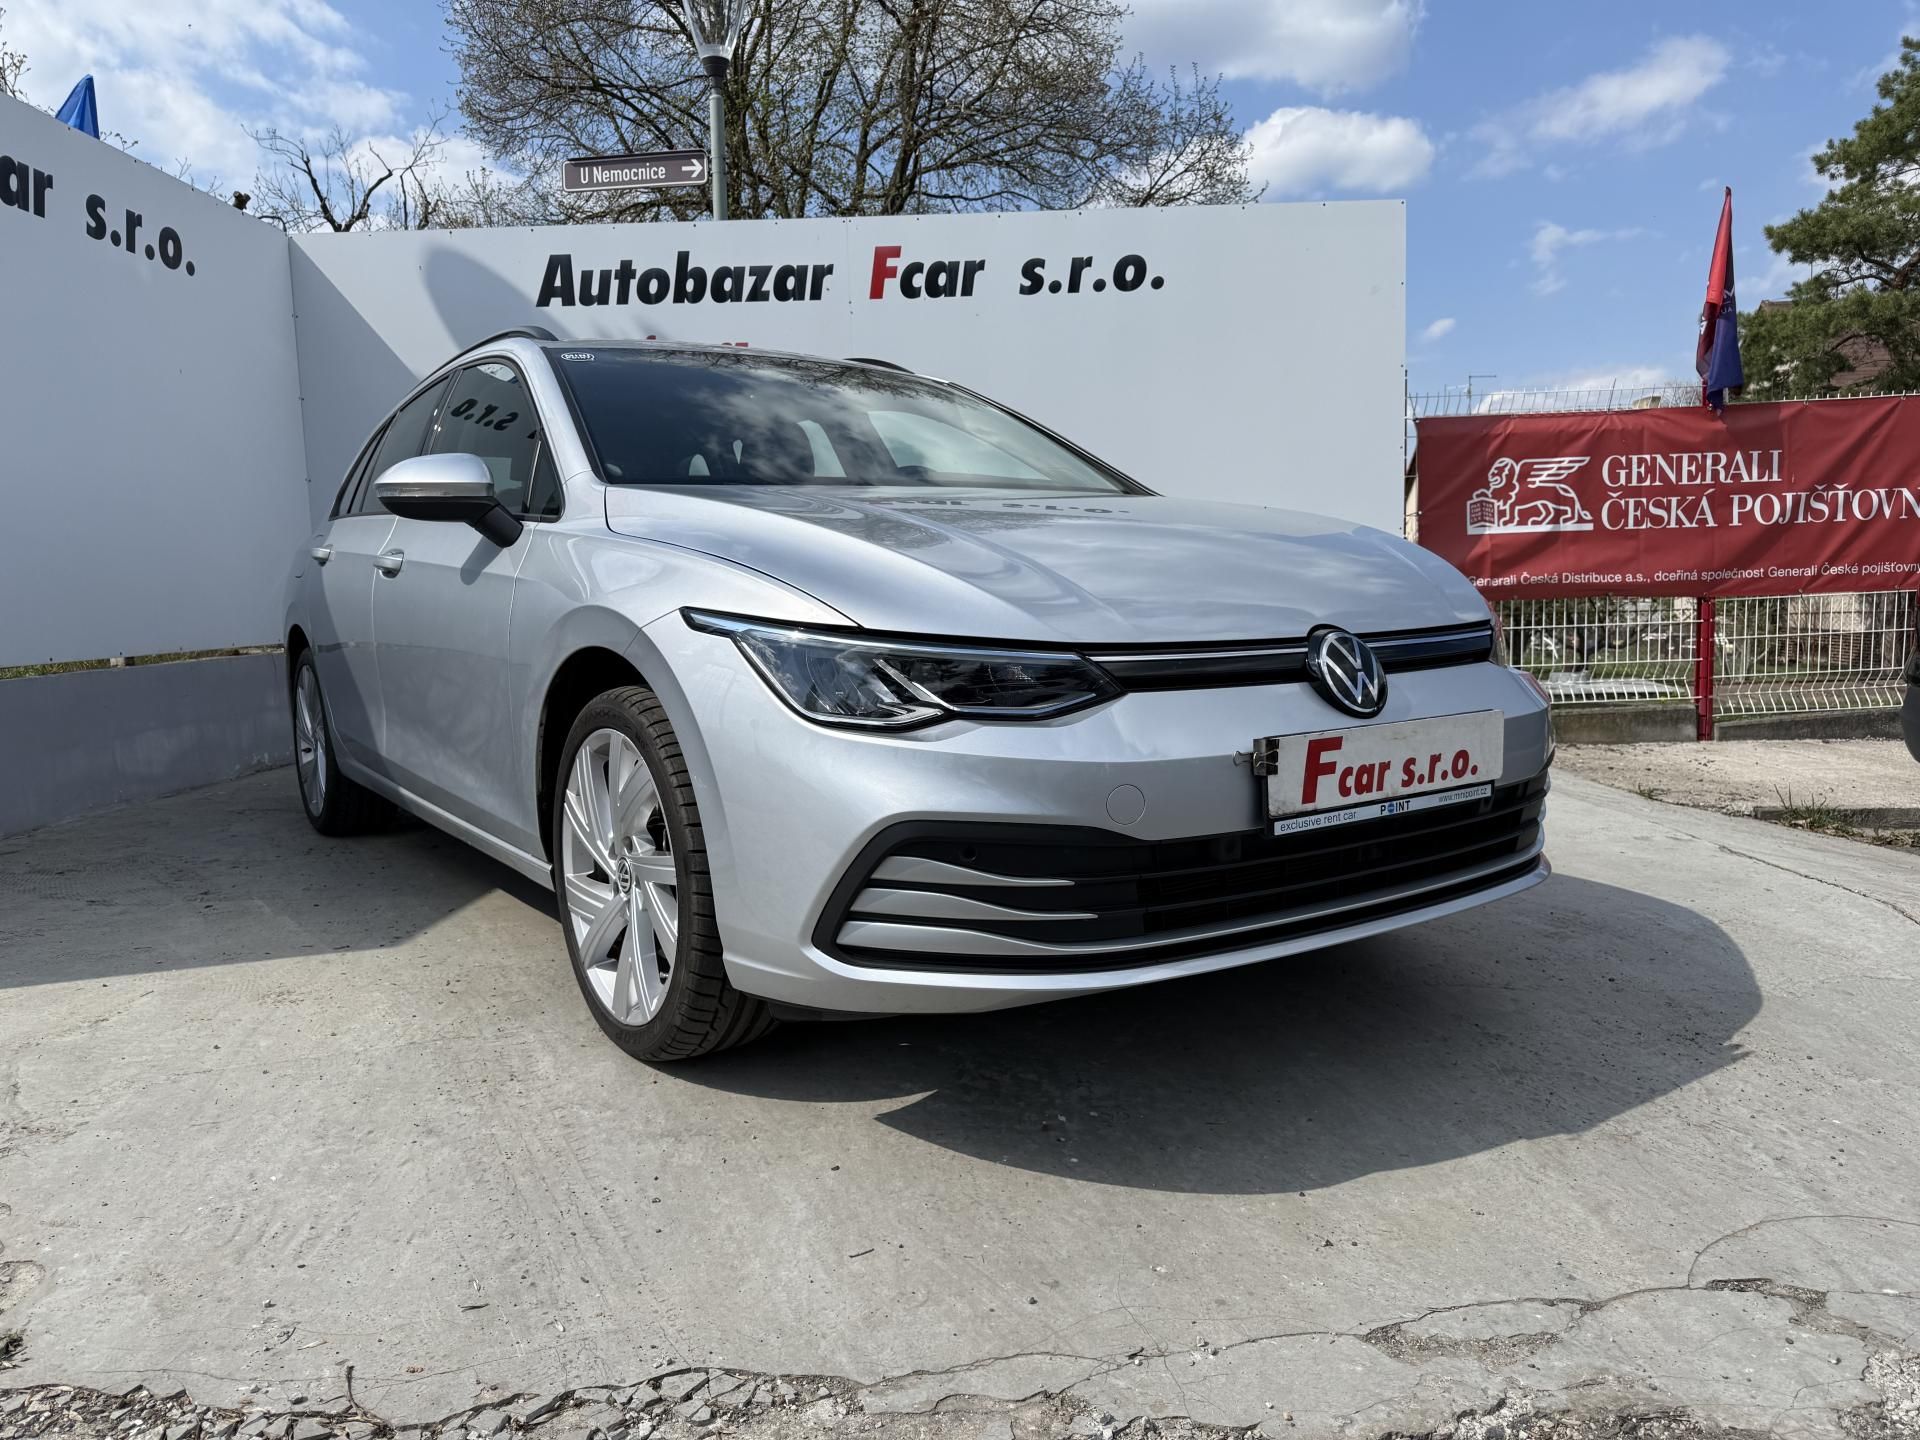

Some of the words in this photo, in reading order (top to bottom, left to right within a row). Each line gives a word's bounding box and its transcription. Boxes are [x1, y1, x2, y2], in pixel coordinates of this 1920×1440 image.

[580, 167, 589, 184] U
[593, 162, 666, 183] Nemocnice
[85, 194, 195, 277] s.r.o.
[536, 251, 834, 307] Autobazar
[869, 245, 985, 300] Fcar
[1019, 254, 1165, 295] s.r.o.
[1601, 449, 1783, 488] GENERALI
[1600, 488, 1718, 531] ČESKÁ
[1520, 571, 1559, 585] Česká
[1562, 571, 1622, 584] Distribuce
[1625, 571, 1650, 583] a.s.,
[1654, 570, 1698, 582] dceřiná
[1700, 567, 1764, 582] společnost
[1768, 565, 1817, 577] Generali
[1821, 563, 1858, 576] České
[1302, 736, 1391, 804] Fcar
[1401, 749, 1478, 788] s.r.o.
[1280, 817, 1322, 832] exclusive
[1324, 814, 1341, 824] rent
[1343, 811, 1357, 821] car
[1380, 800, 1411, 815] POINT
